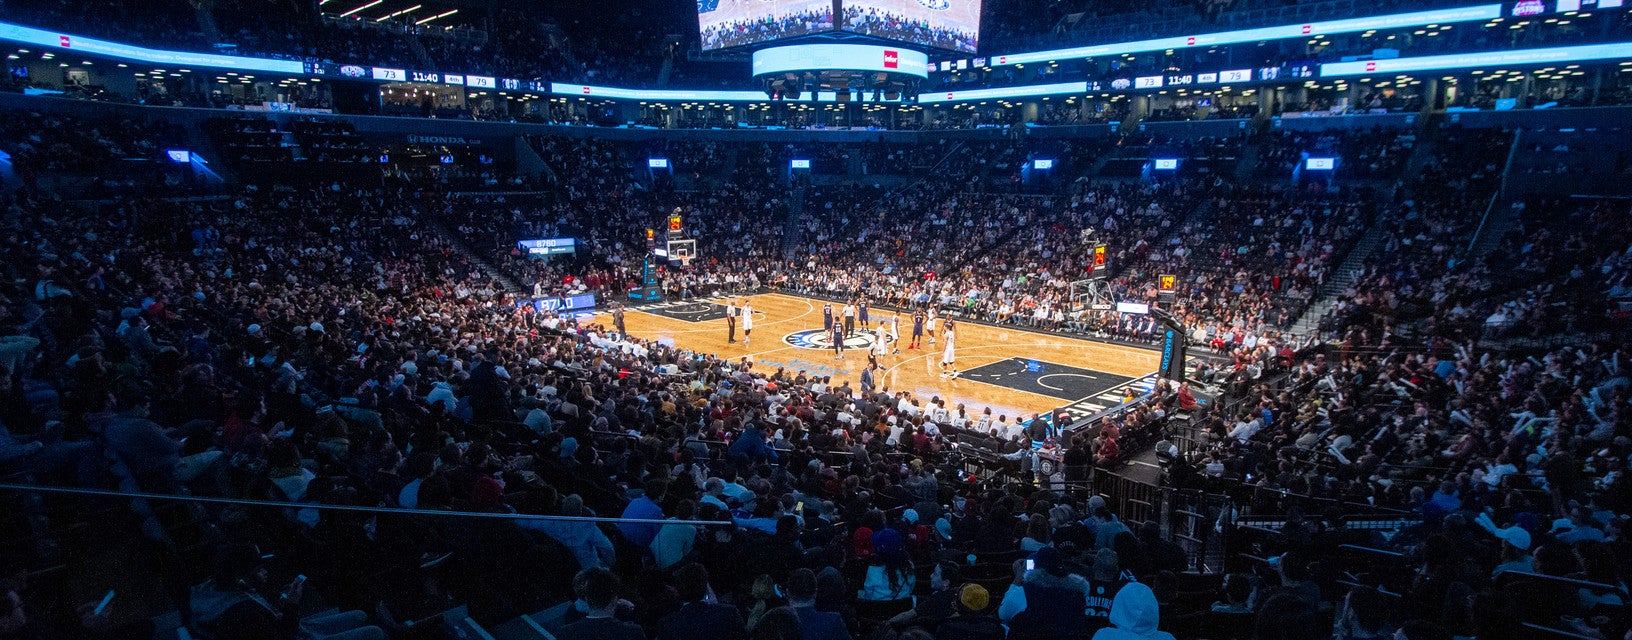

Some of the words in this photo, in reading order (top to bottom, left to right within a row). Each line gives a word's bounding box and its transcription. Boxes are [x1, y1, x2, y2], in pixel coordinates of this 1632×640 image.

[383, 70, 396, 78] 73
[412, 72, 438, 82] 11:40
[476, 78, 487, 86] 79
[1144, 78, 1155, 86] 73
[1168, 75, 1192, 85] 11:40
[1230, 72, 1241, 80] 79
[419, 136, 466, 144] HONDA
[1162, 338, 1173, 371] BARCLAYS
